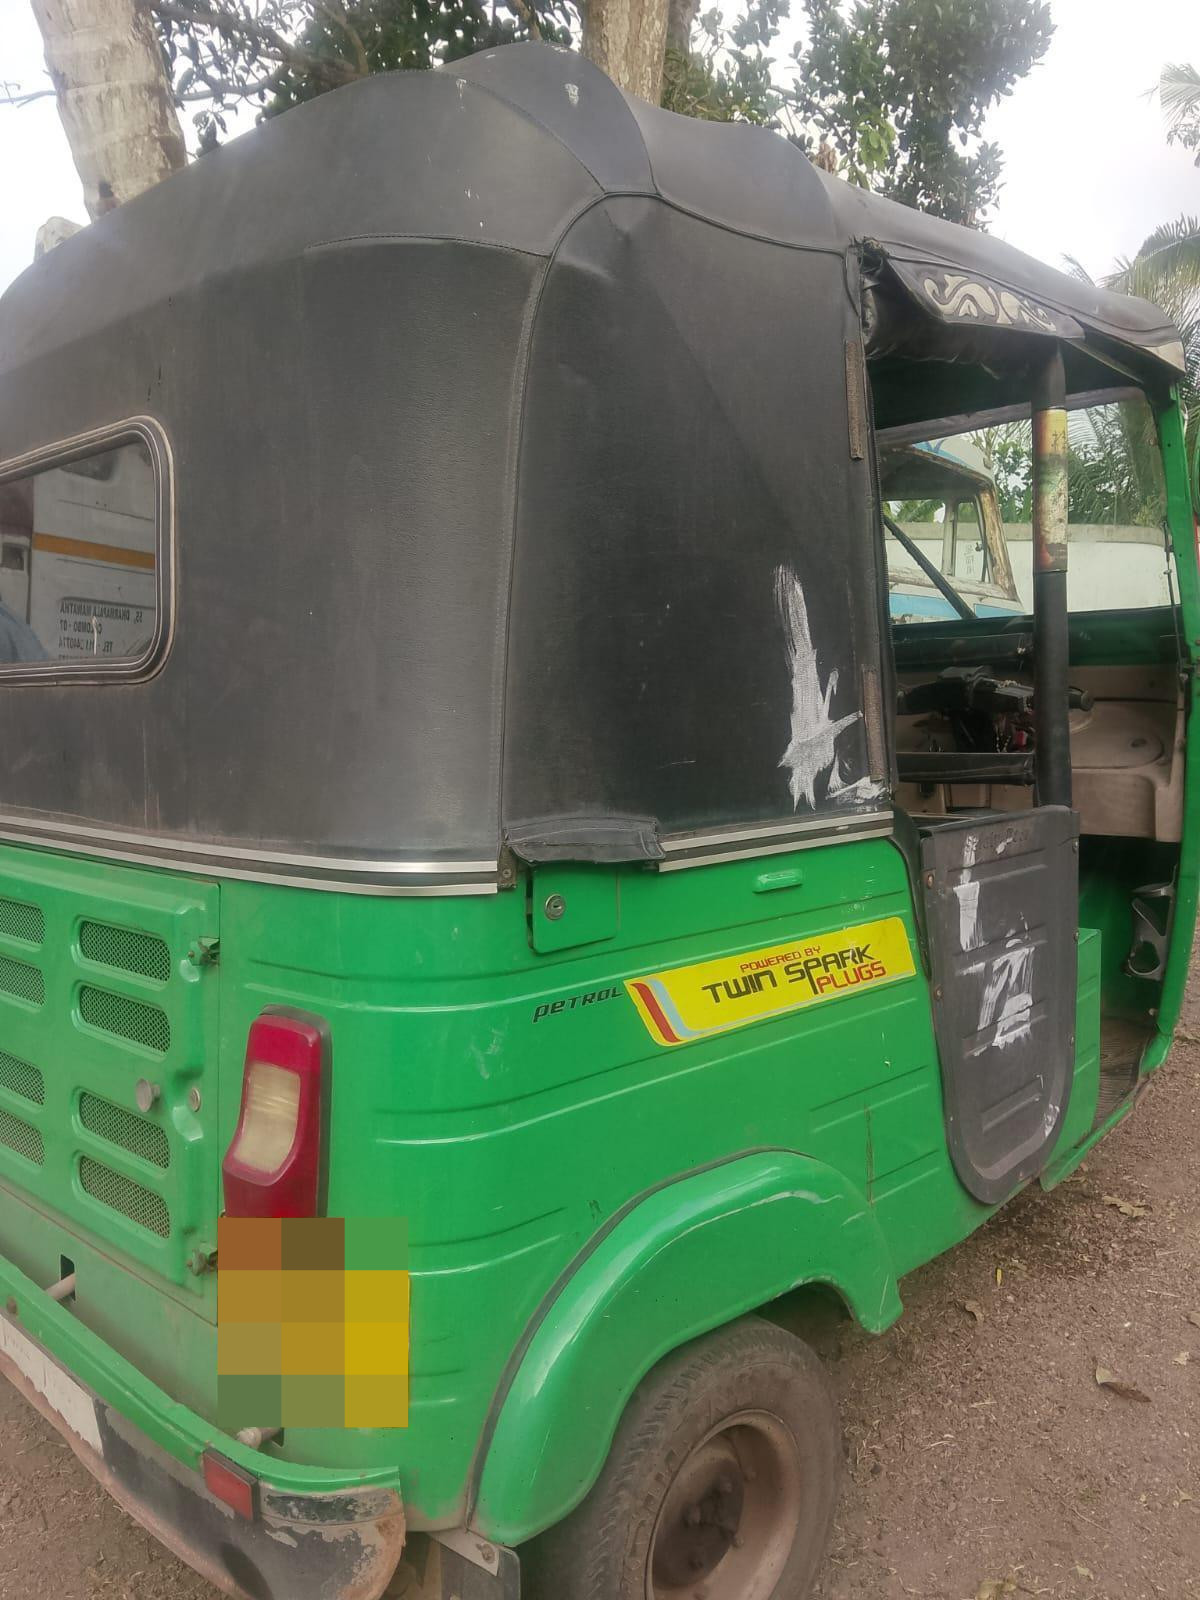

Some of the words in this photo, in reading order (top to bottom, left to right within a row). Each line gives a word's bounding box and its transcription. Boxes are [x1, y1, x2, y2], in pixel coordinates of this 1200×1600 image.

[701, 970, 777, 1004] TWIN
[784, 944, 875, 995] SPARK
[740, 951, 802, 973] POWERED
[804, 945, 821, 957] BY
[815, 960, 887, 994] PLUGS
